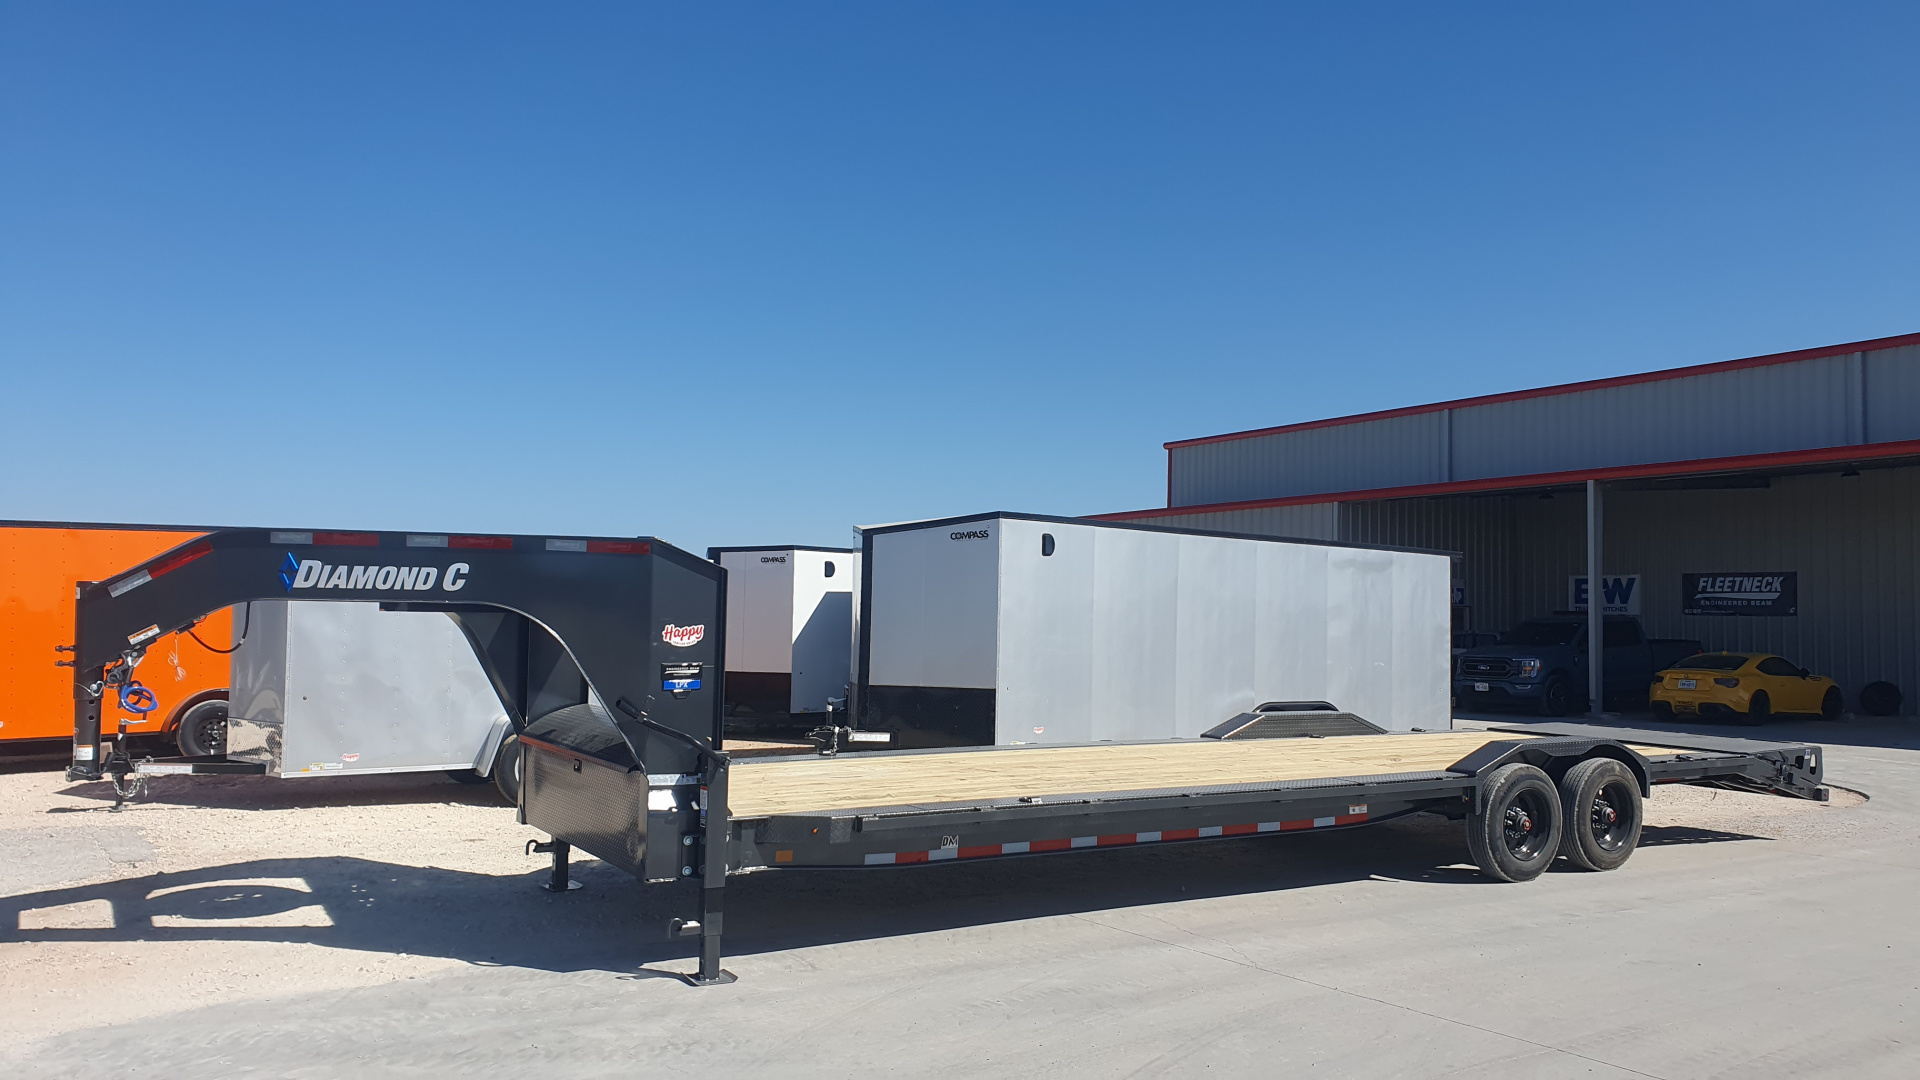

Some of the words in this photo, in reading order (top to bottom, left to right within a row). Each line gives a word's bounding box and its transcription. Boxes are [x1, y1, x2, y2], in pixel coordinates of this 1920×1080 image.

[950, 530, 989, 540] COMPASS
[292, 560, 438, 591] DIAMOND
[442, 562, 470, 592] C
[1697, 577, 1784, 592] FLEETNECK
[664, 626, 703, 641] Happy
